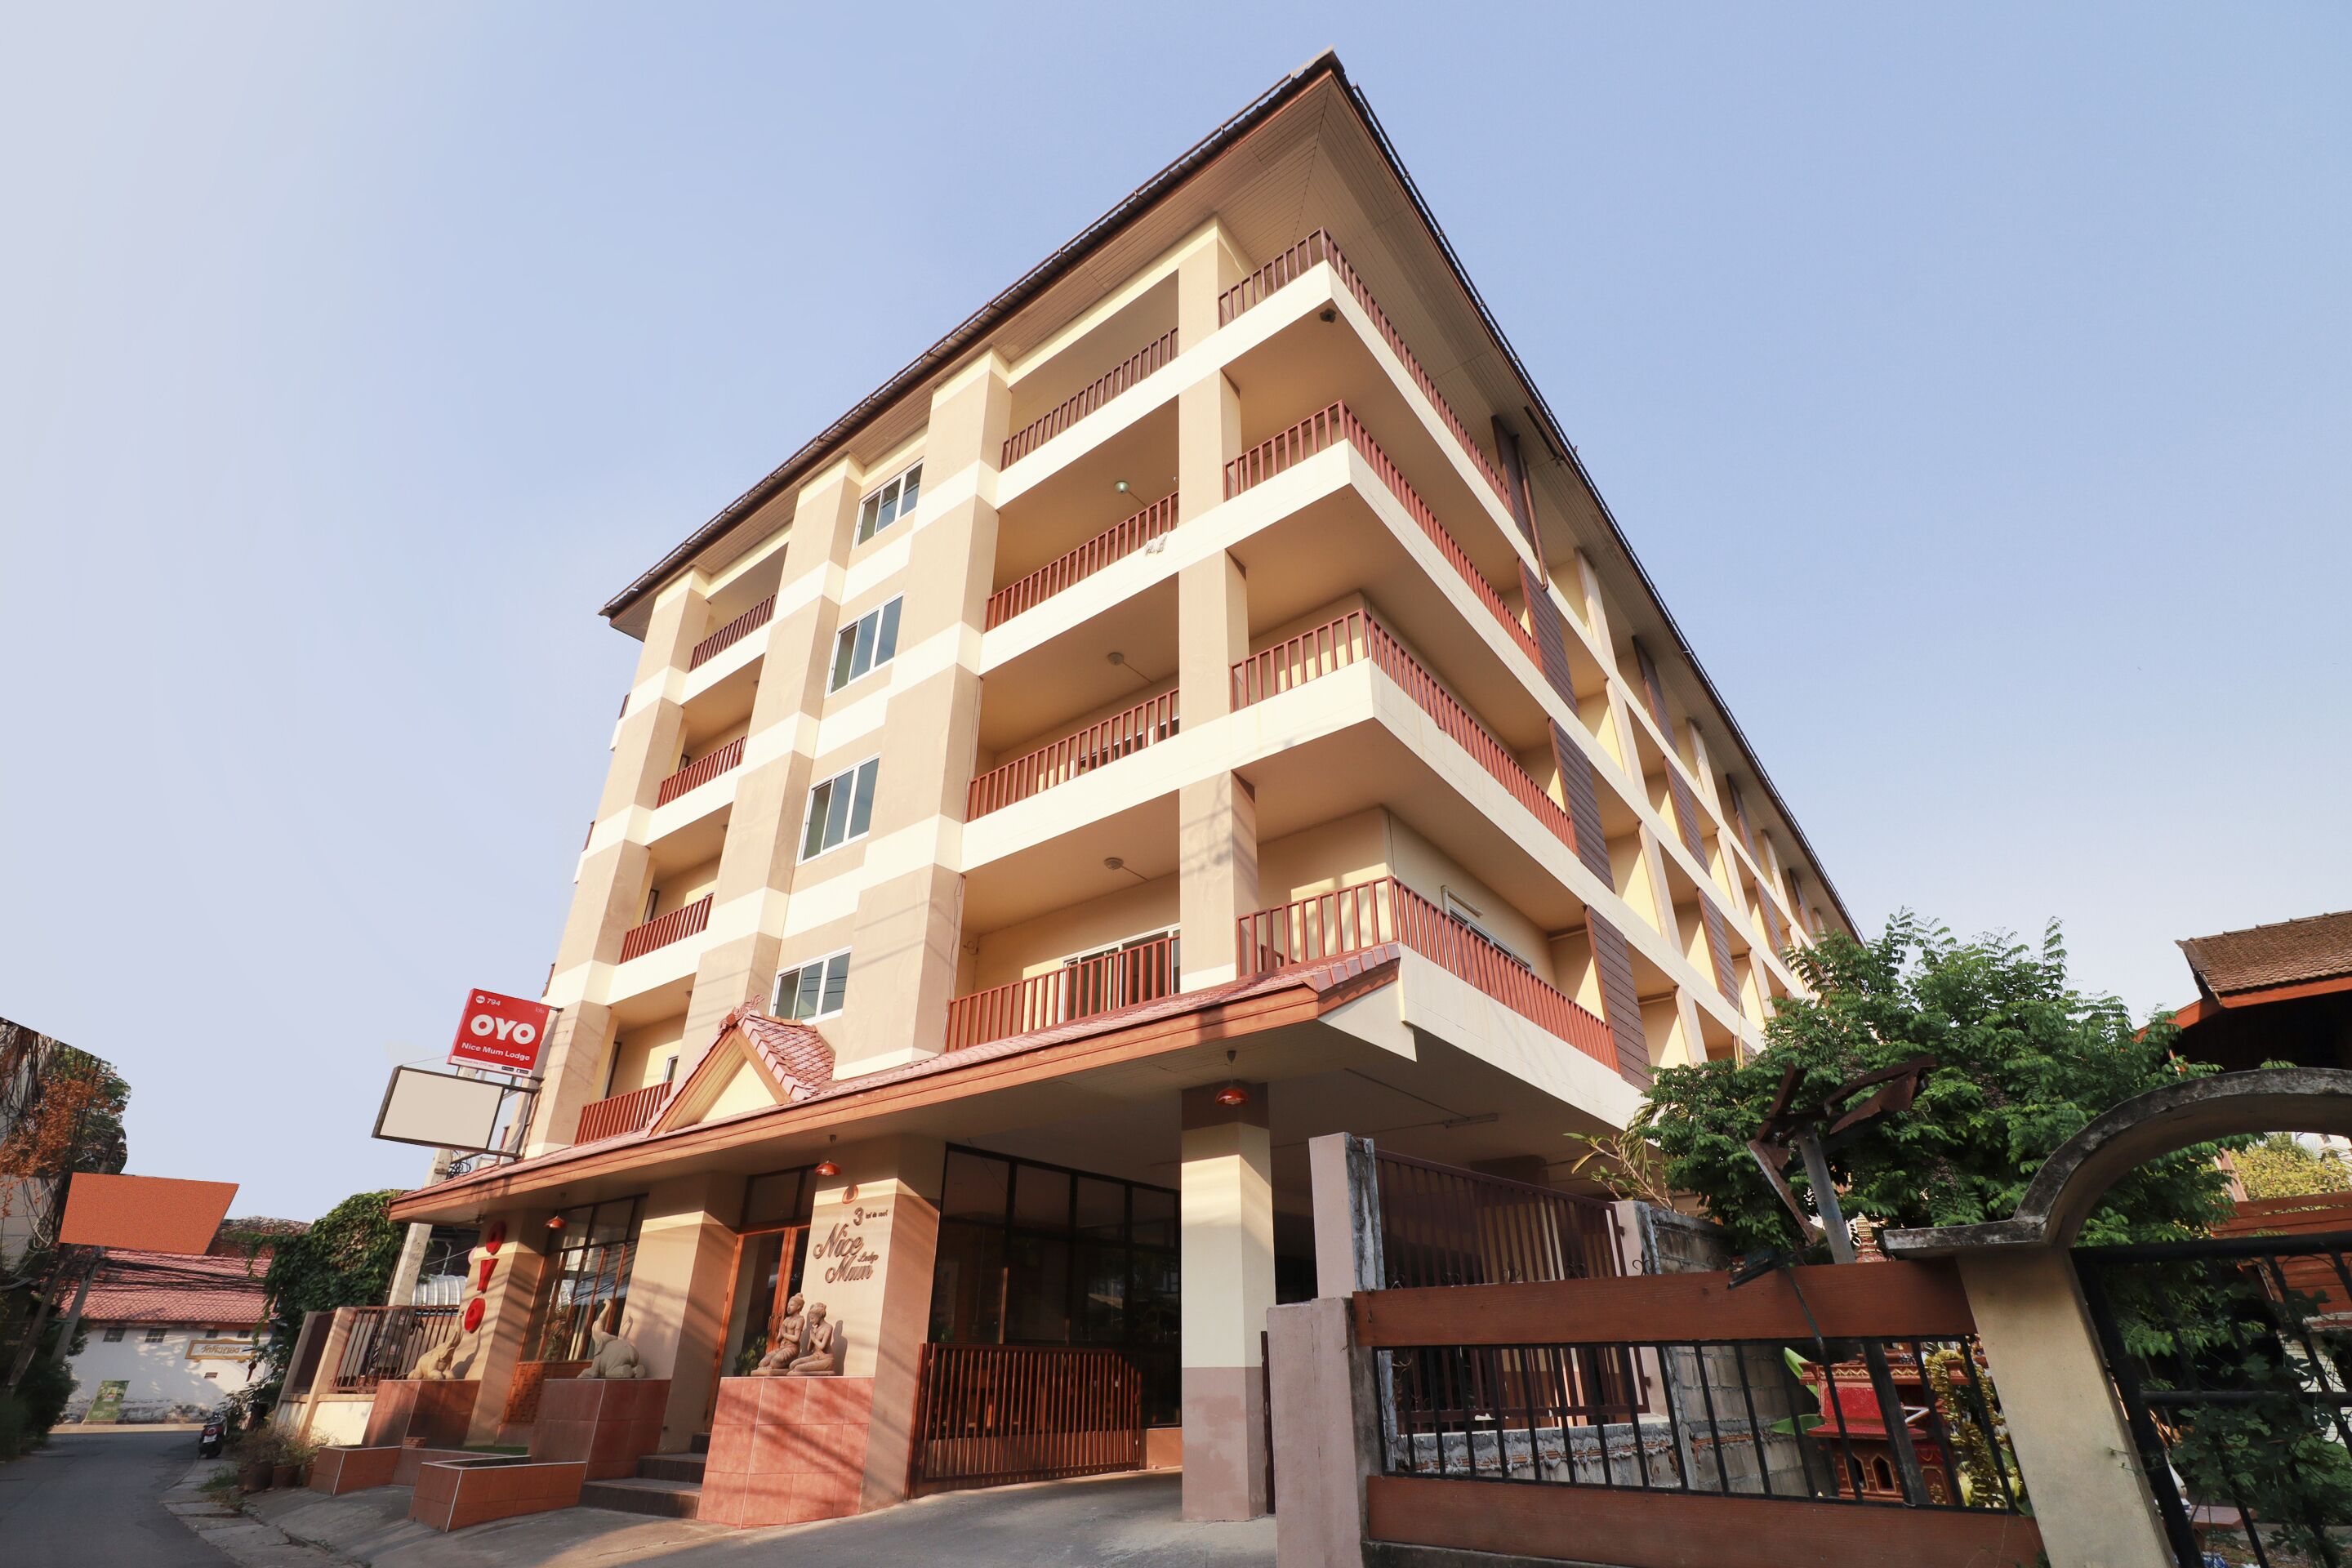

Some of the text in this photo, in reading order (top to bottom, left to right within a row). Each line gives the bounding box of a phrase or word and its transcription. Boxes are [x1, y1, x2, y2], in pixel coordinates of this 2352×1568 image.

[487, 998, 501, 1006] 794
[470, 1014, 536, 1045] OYO
[461, 1042, 530, 1062] Nice Mum Lodge
[813, 1223, 864, 1259] Nice
[825, 1255, 874, 1284] Mum
